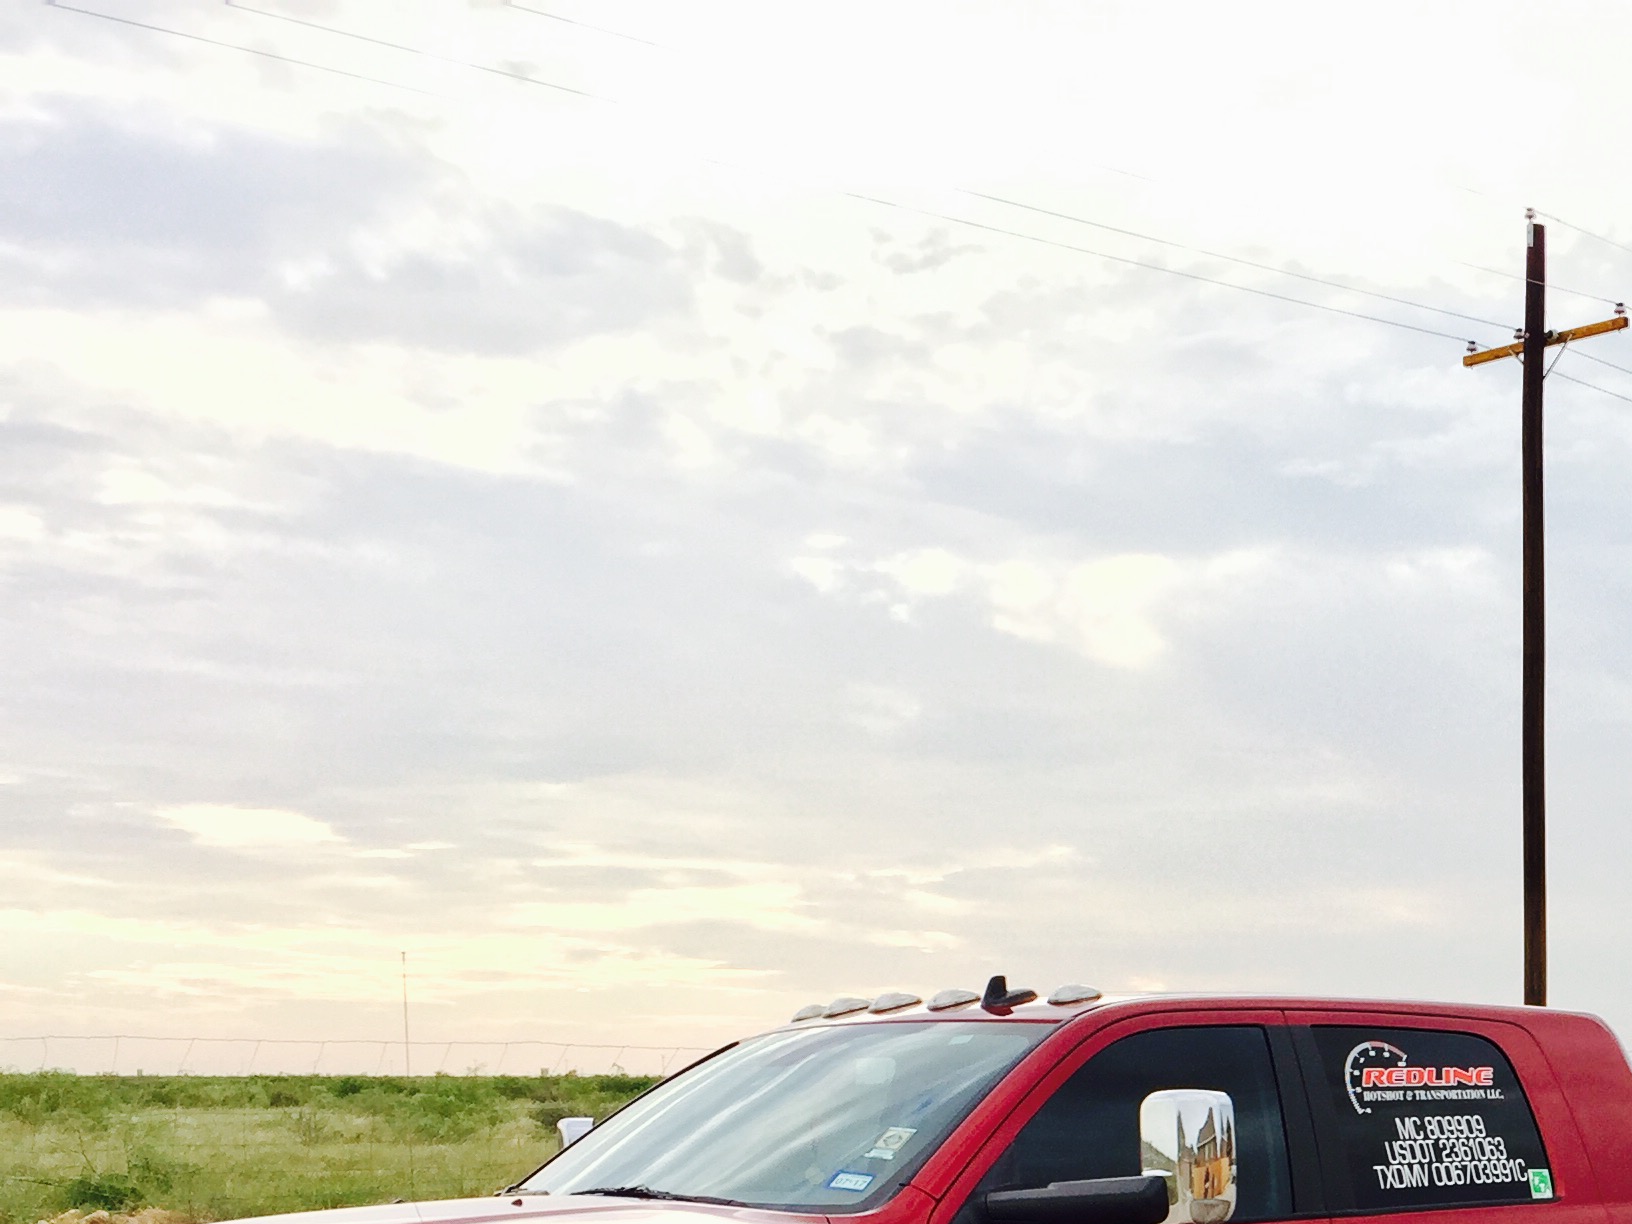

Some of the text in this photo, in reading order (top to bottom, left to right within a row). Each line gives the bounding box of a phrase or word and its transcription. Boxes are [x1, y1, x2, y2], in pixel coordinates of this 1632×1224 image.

[1362, 1066, 1494, 1087] REDLINE
[1363, 1090, 1404, 1101] HOTSHOT
[1406, 1090, 1414, 1100] &
[1415, 1089, 1485, 1100] TRANSPORTATION
[1395, 1115, 1486, 1139] MC 809909
[1385, 1137, 1507, 1164] USDOT 2361063
[1373, 1159, 1528, 1189] TXDMV 006703991C
